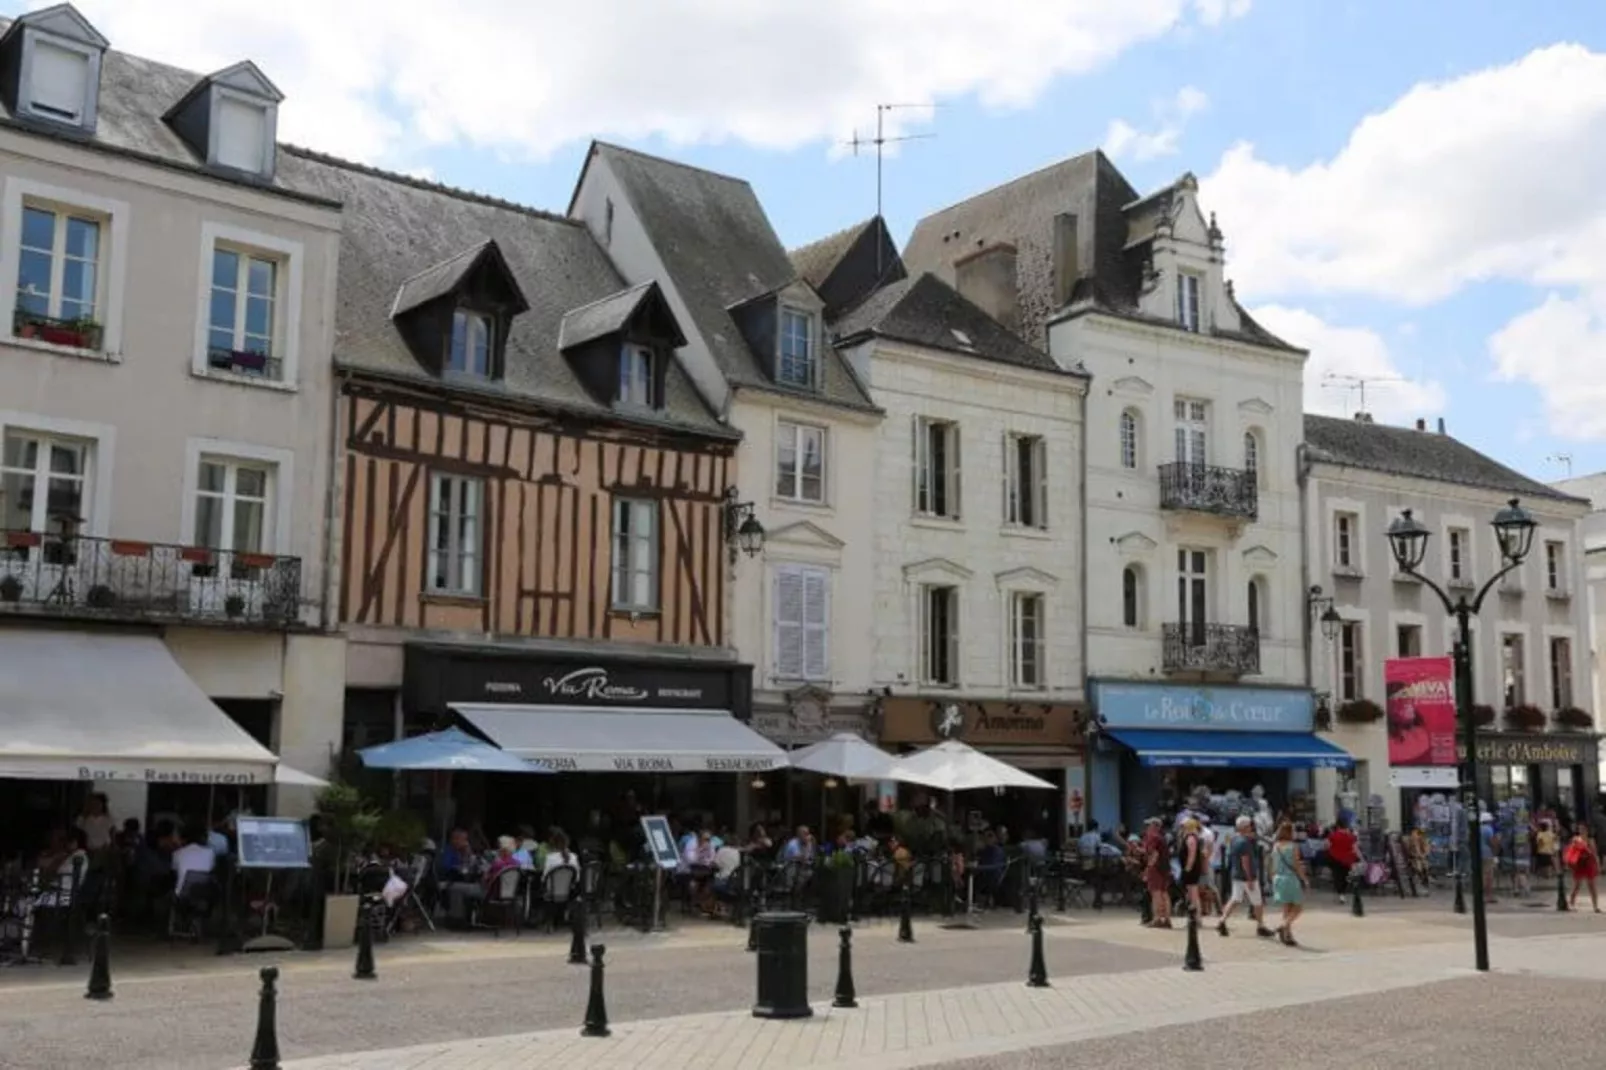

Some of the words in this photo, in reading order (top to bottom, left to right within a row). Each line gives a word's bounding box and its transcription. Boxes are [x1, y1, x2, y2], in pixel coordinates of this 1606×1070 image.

[585, 676, 648, 701] Roma
[975, 713, 1045, 731] Amorino
[612, 757, 634, 770] VIA
[637, 757, 674, 770] ROMA
[78, 765, 118, 780] Bar
[144, 767, 256, 784] Restaurant
